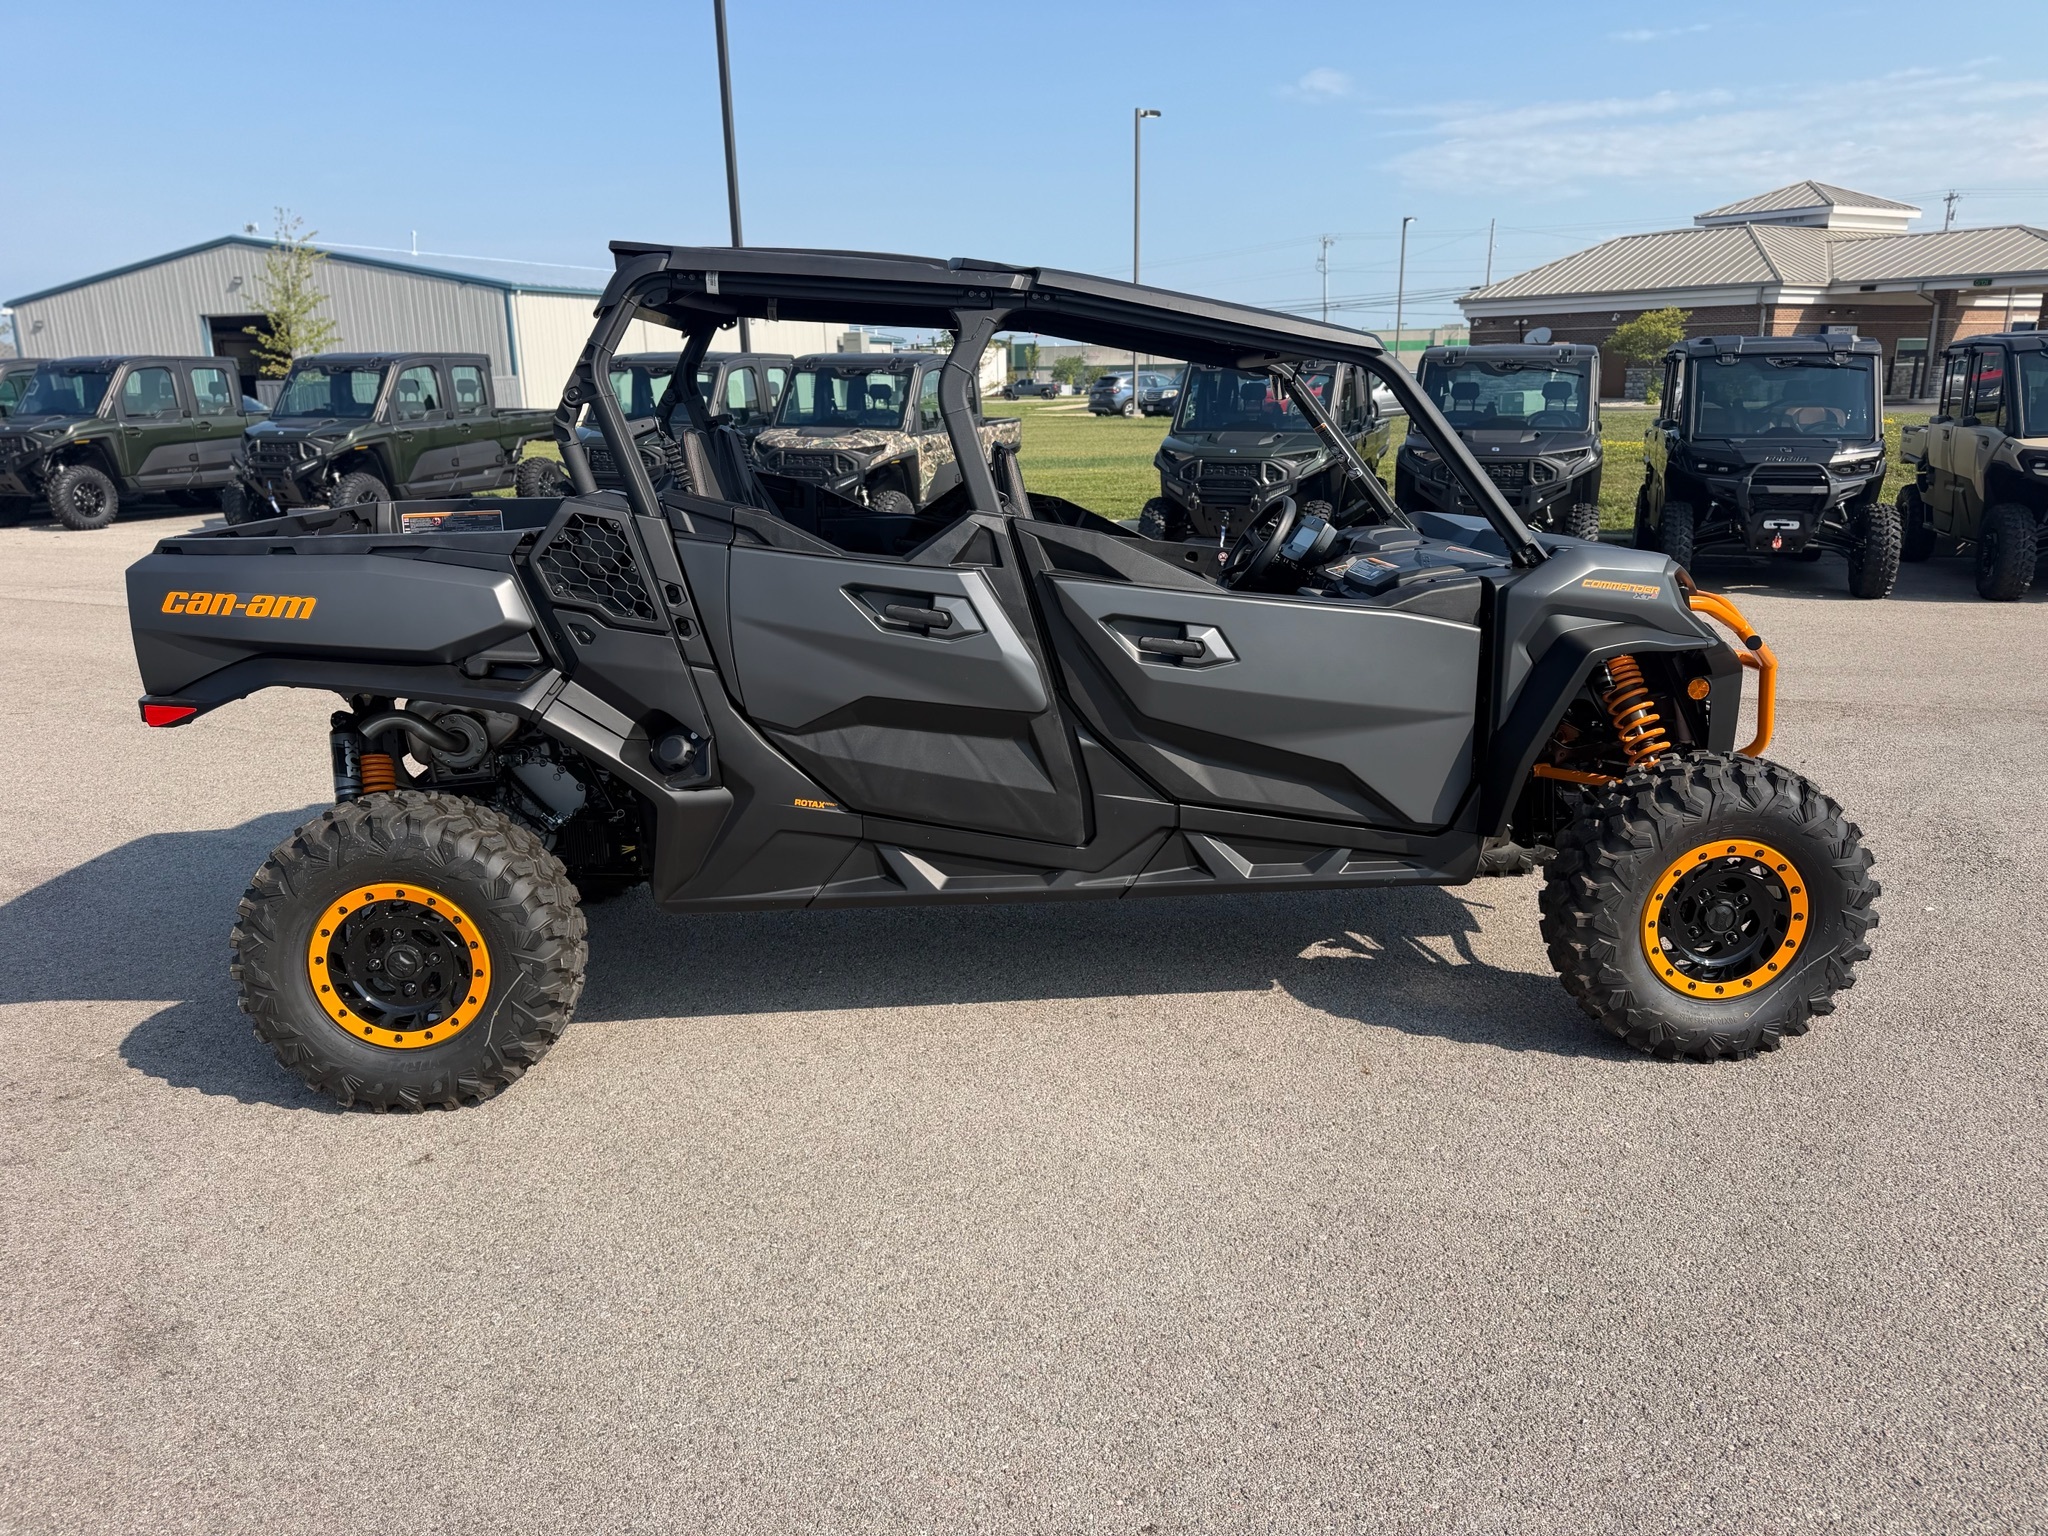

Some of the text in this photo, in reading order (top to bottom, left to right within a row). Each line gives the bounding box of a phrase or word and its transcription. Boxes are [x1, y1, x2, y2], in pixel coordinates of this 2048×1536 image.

[1489, 468, 1524, 477] ARIS
[1581, 579, 1661, 595] COMMANDER
[161, 591, 317, 620] can-am
[344, 740, 361, 778] FOX
[794, 798, 825, 809] ROTAX
